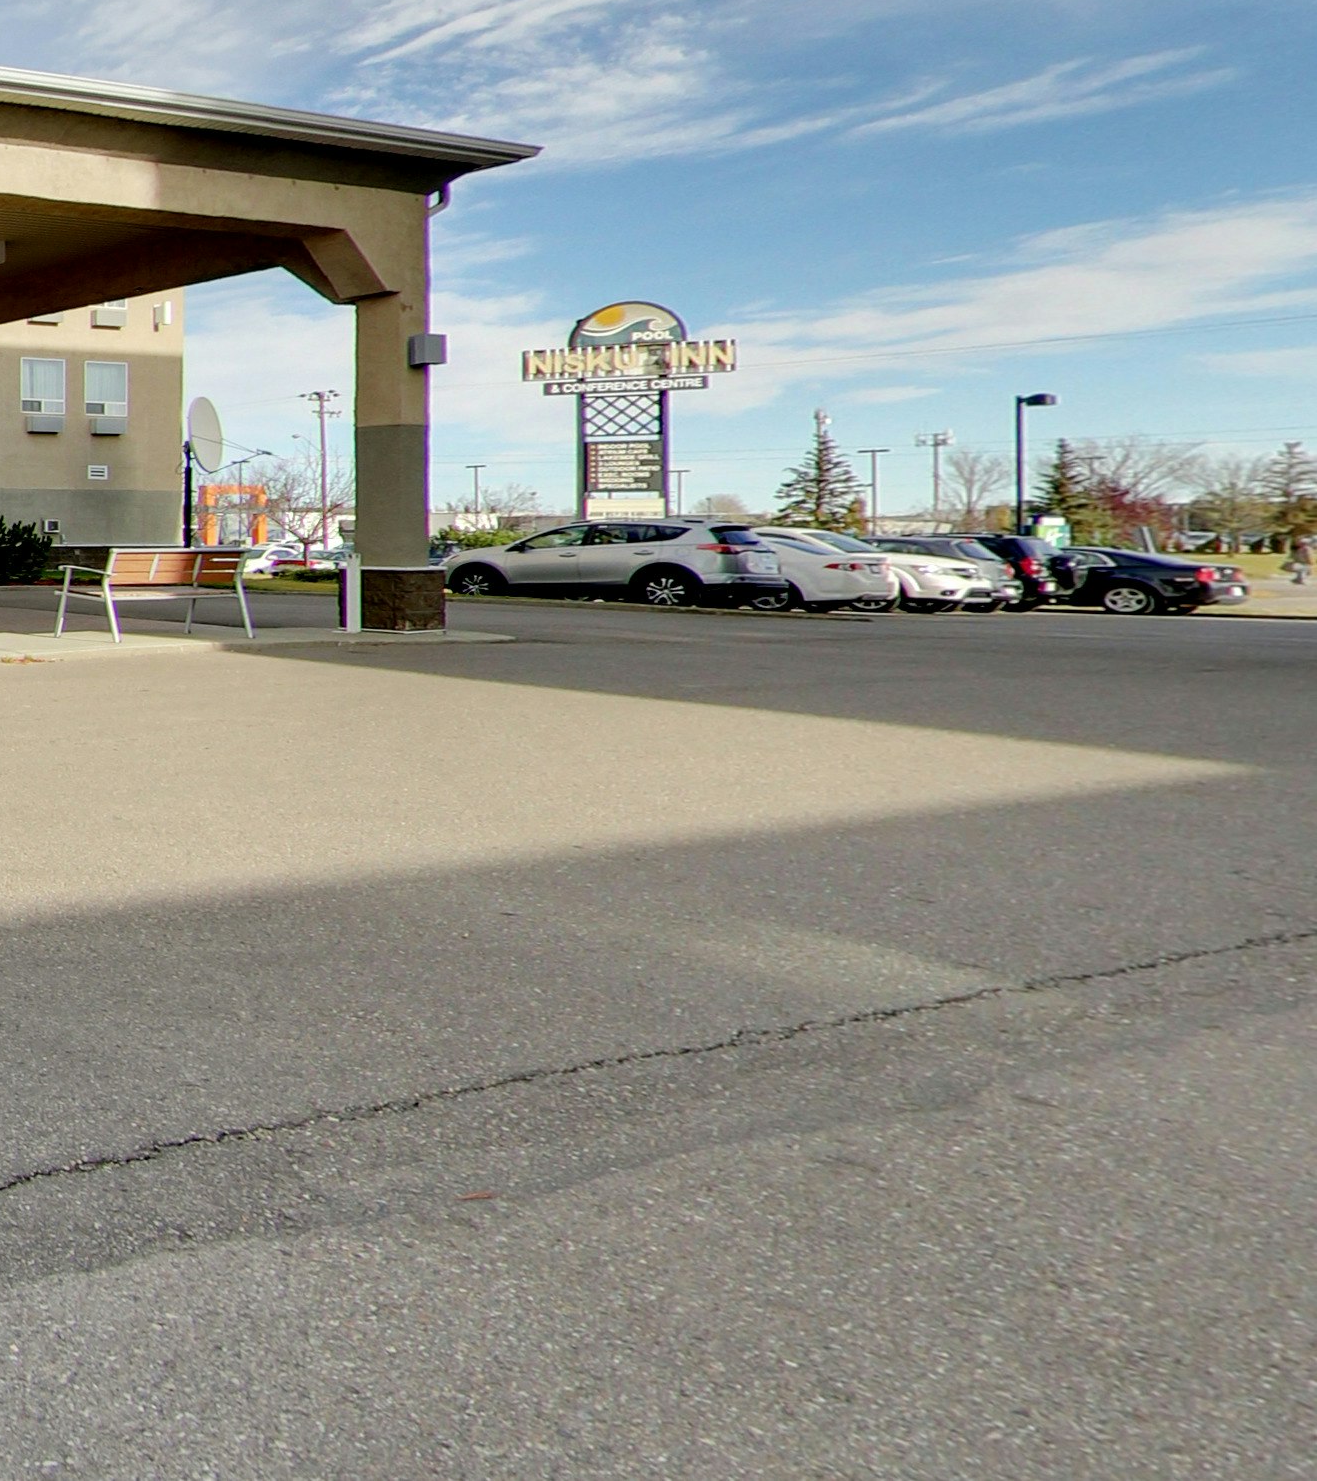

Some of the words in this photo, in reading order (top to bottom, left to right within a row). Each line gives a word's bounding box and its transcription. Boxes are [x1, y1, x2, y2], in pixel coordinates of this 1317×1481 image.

[632, 330, 673, 341] POOL
[528, 346, 637, 376] NISKU
[669, 340, 734, 371] INN
[563, 380, 648, 393] CONFERENCE
[651, 377, 703, 389] CENTRE
